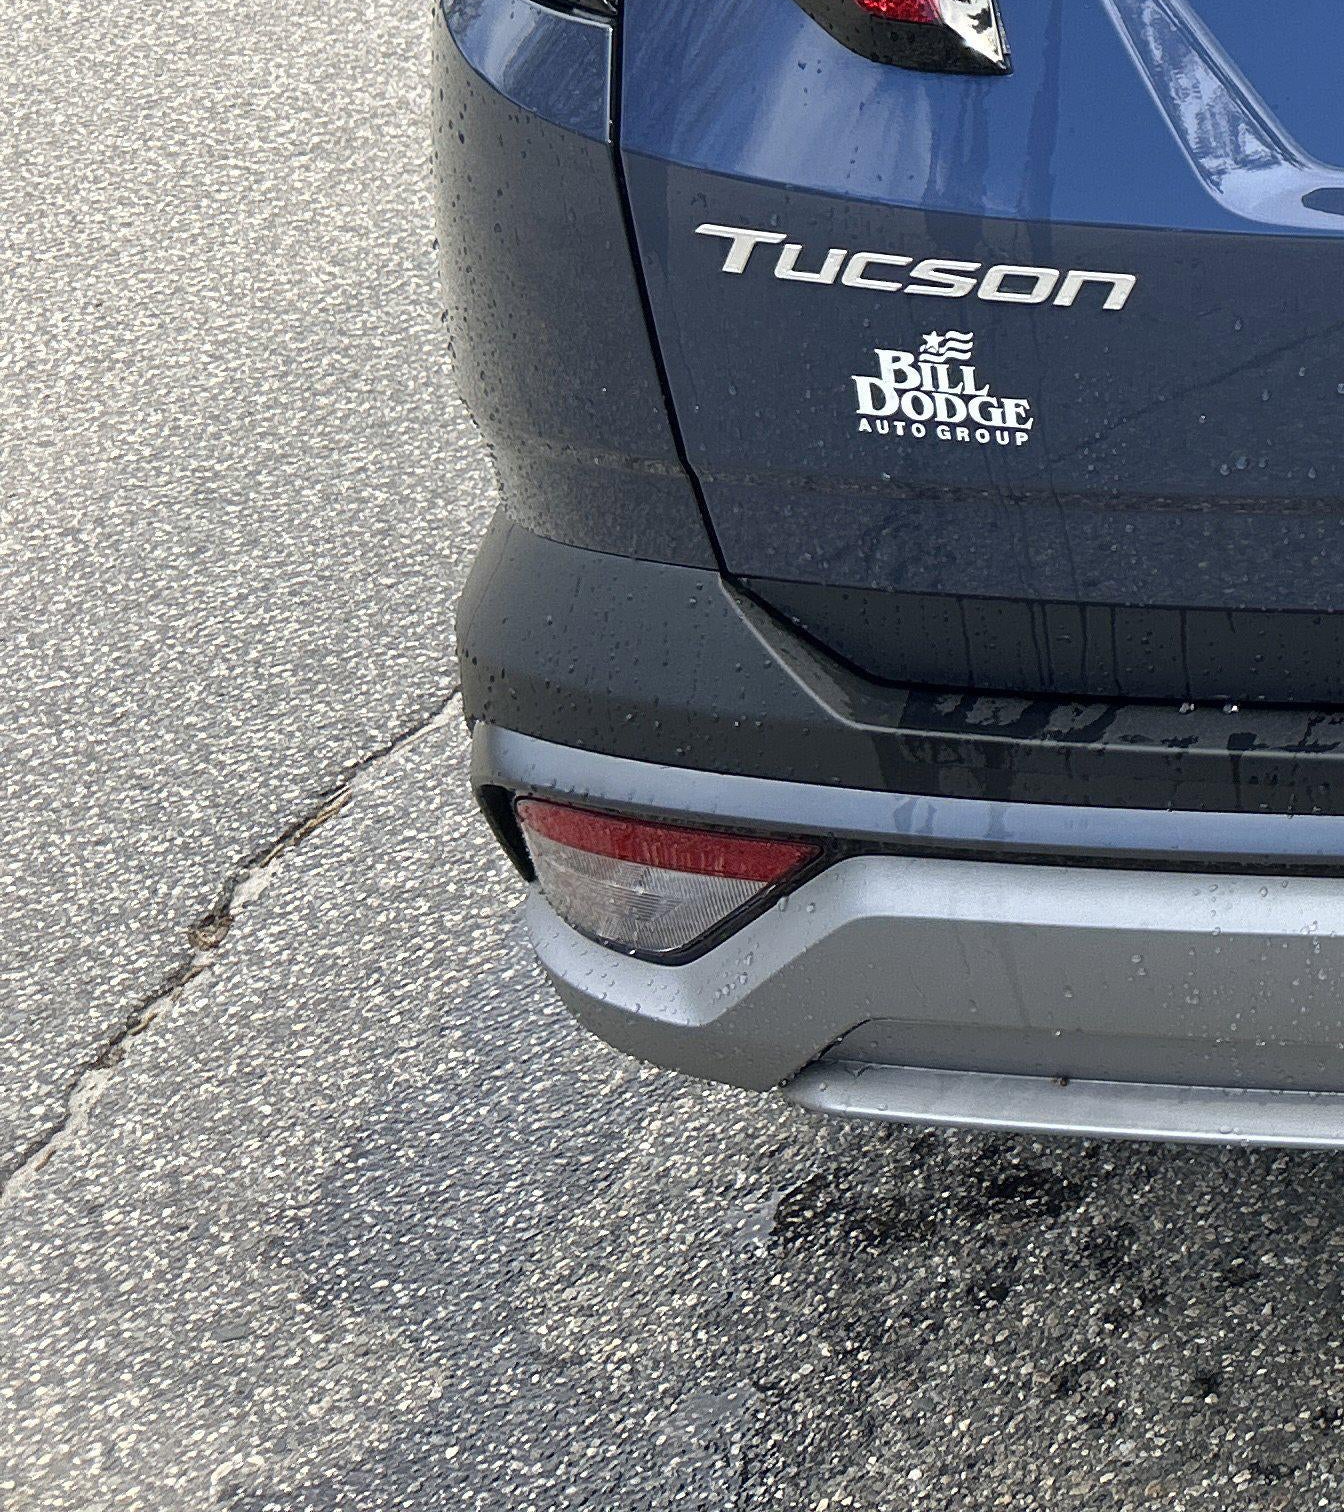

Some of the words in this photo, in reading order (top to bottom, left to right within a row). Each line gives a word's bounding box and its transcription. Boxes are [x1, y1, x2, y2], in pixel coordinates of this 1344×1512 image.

[695, 223, 1136, 310] TUCSON
[874, 348, 990, 397] BILL
[851, 375, 1034, 429] DODGE
[858, 418, 926, 438] AUTO
[936, 425, 1029, 446] GROUP
